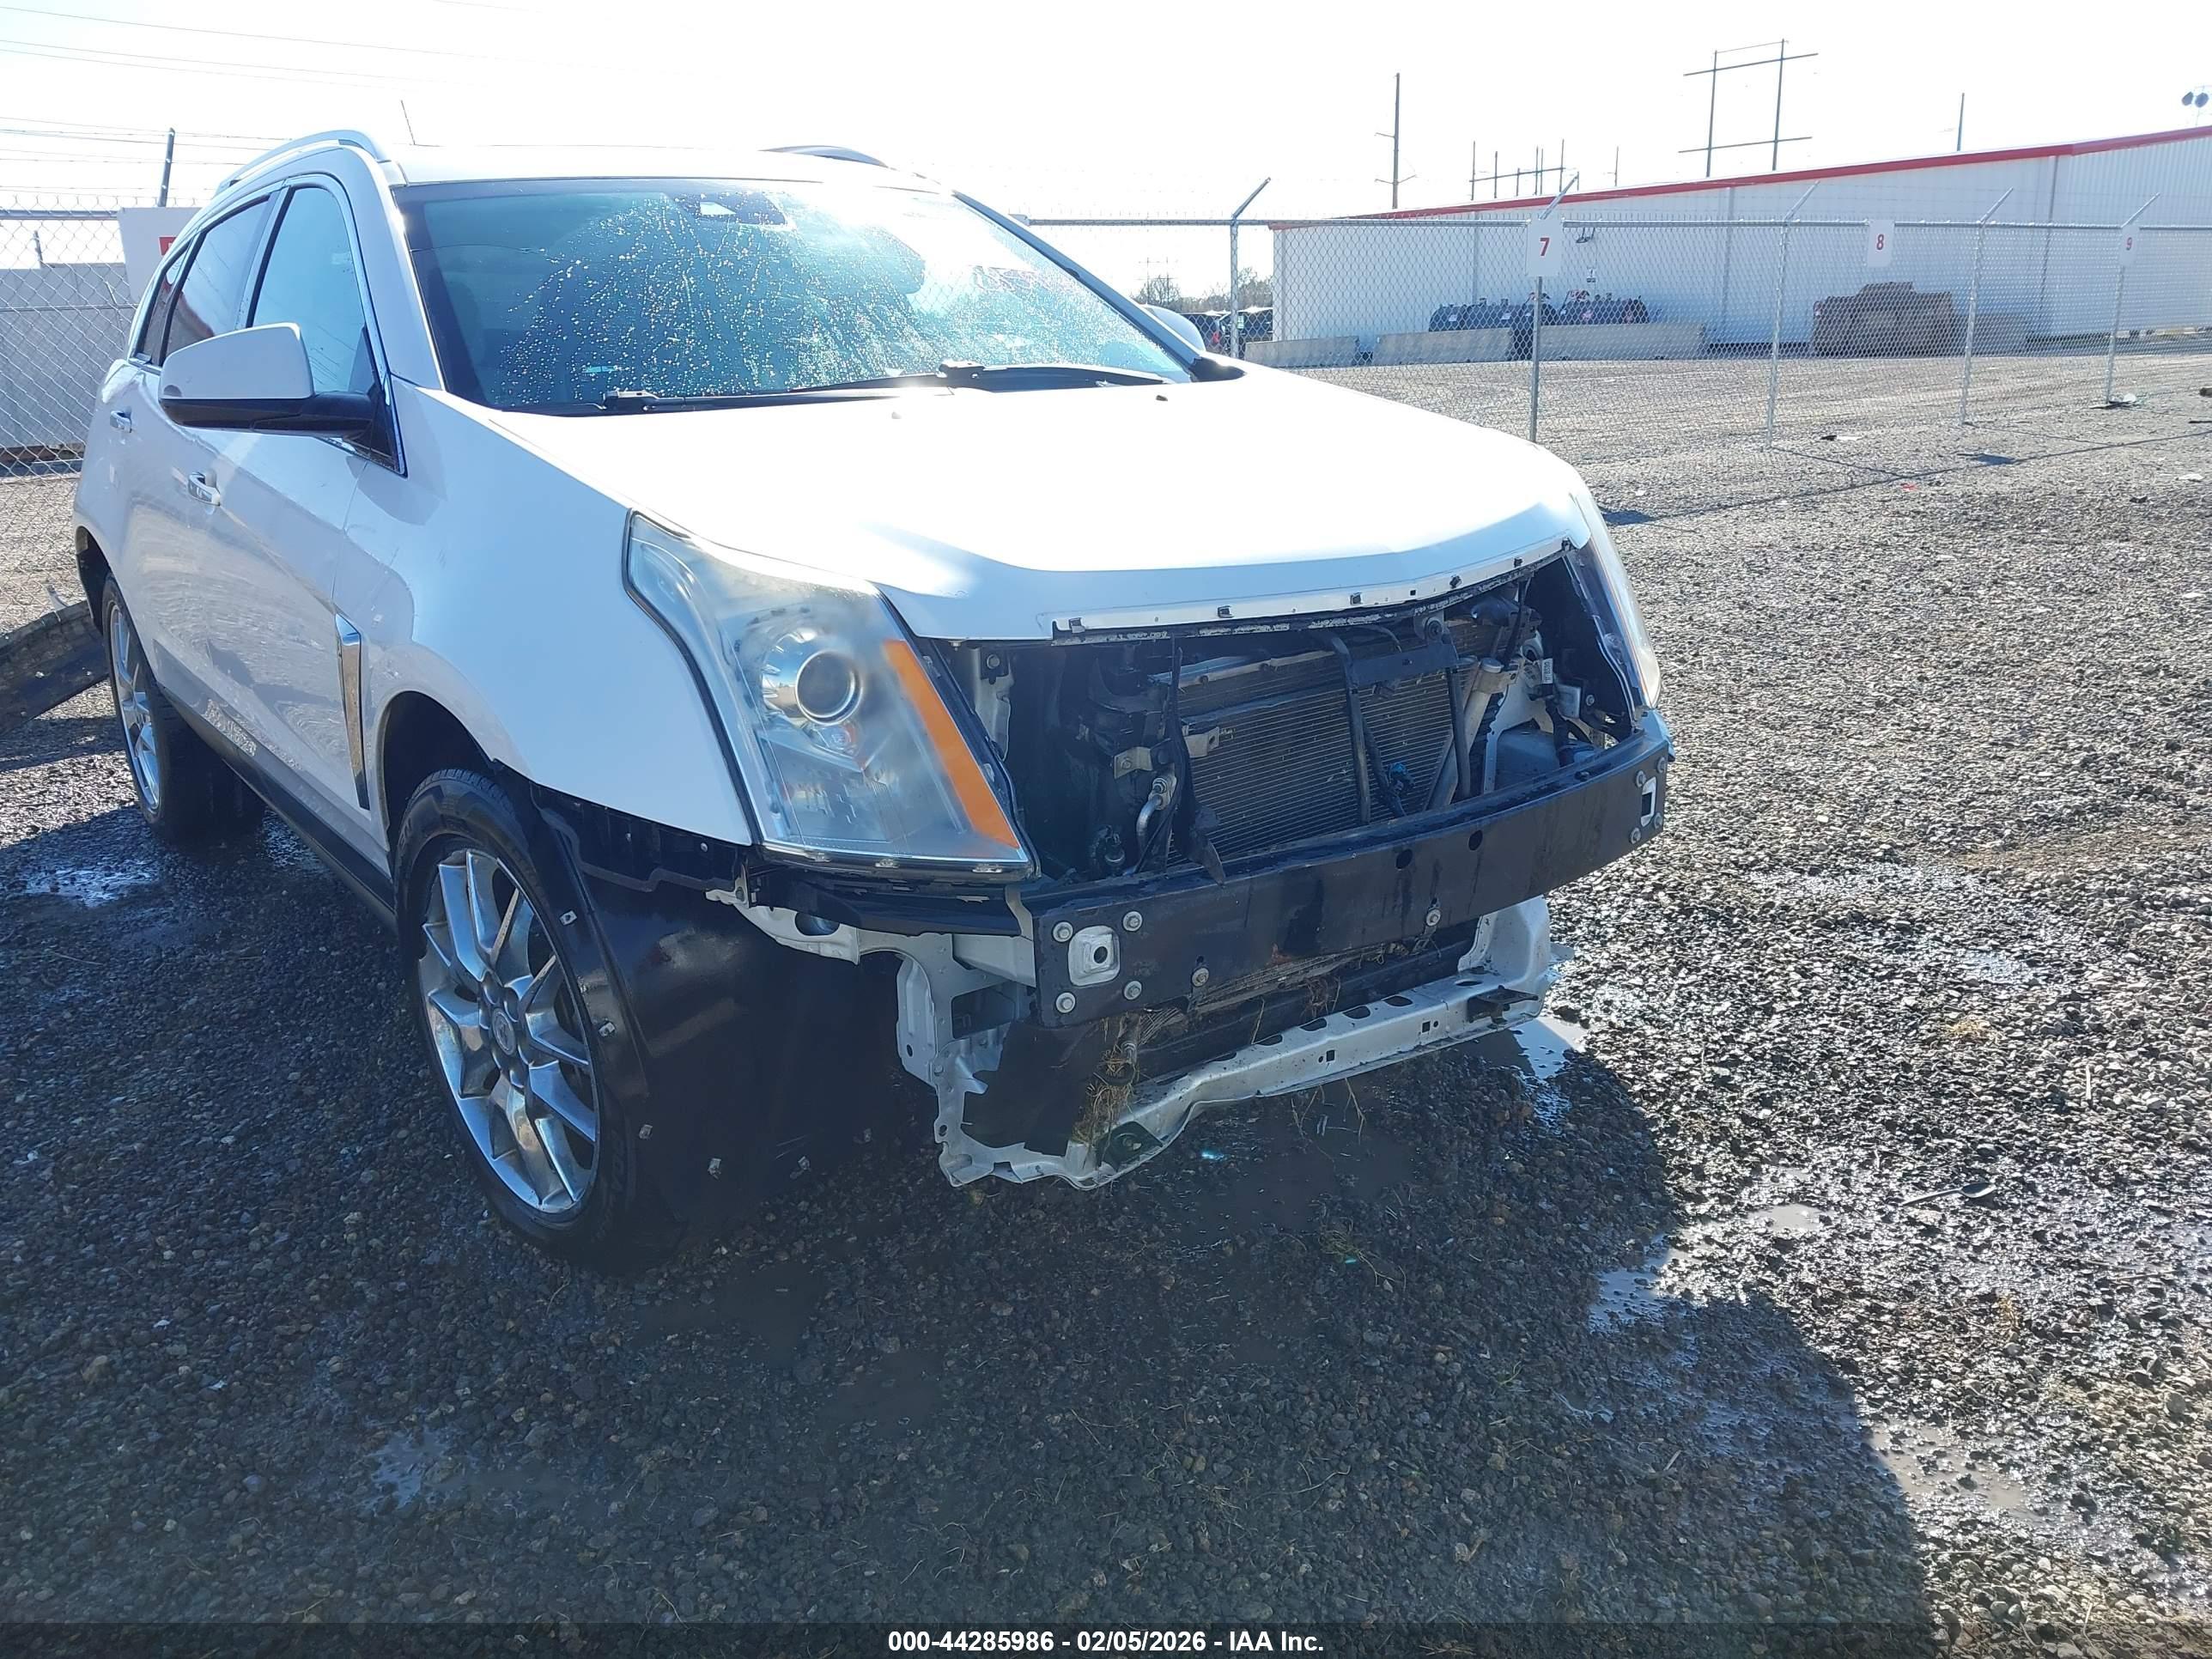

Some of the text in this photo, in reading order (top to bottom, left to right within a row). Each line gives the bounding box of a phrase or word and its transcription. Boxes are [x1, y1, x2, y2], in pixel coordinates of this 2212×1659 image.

[1540, 237, 1550, 257] 7
[1876, 234, 1884, 250] 8
[2126, 237, 2133, 251] 9
